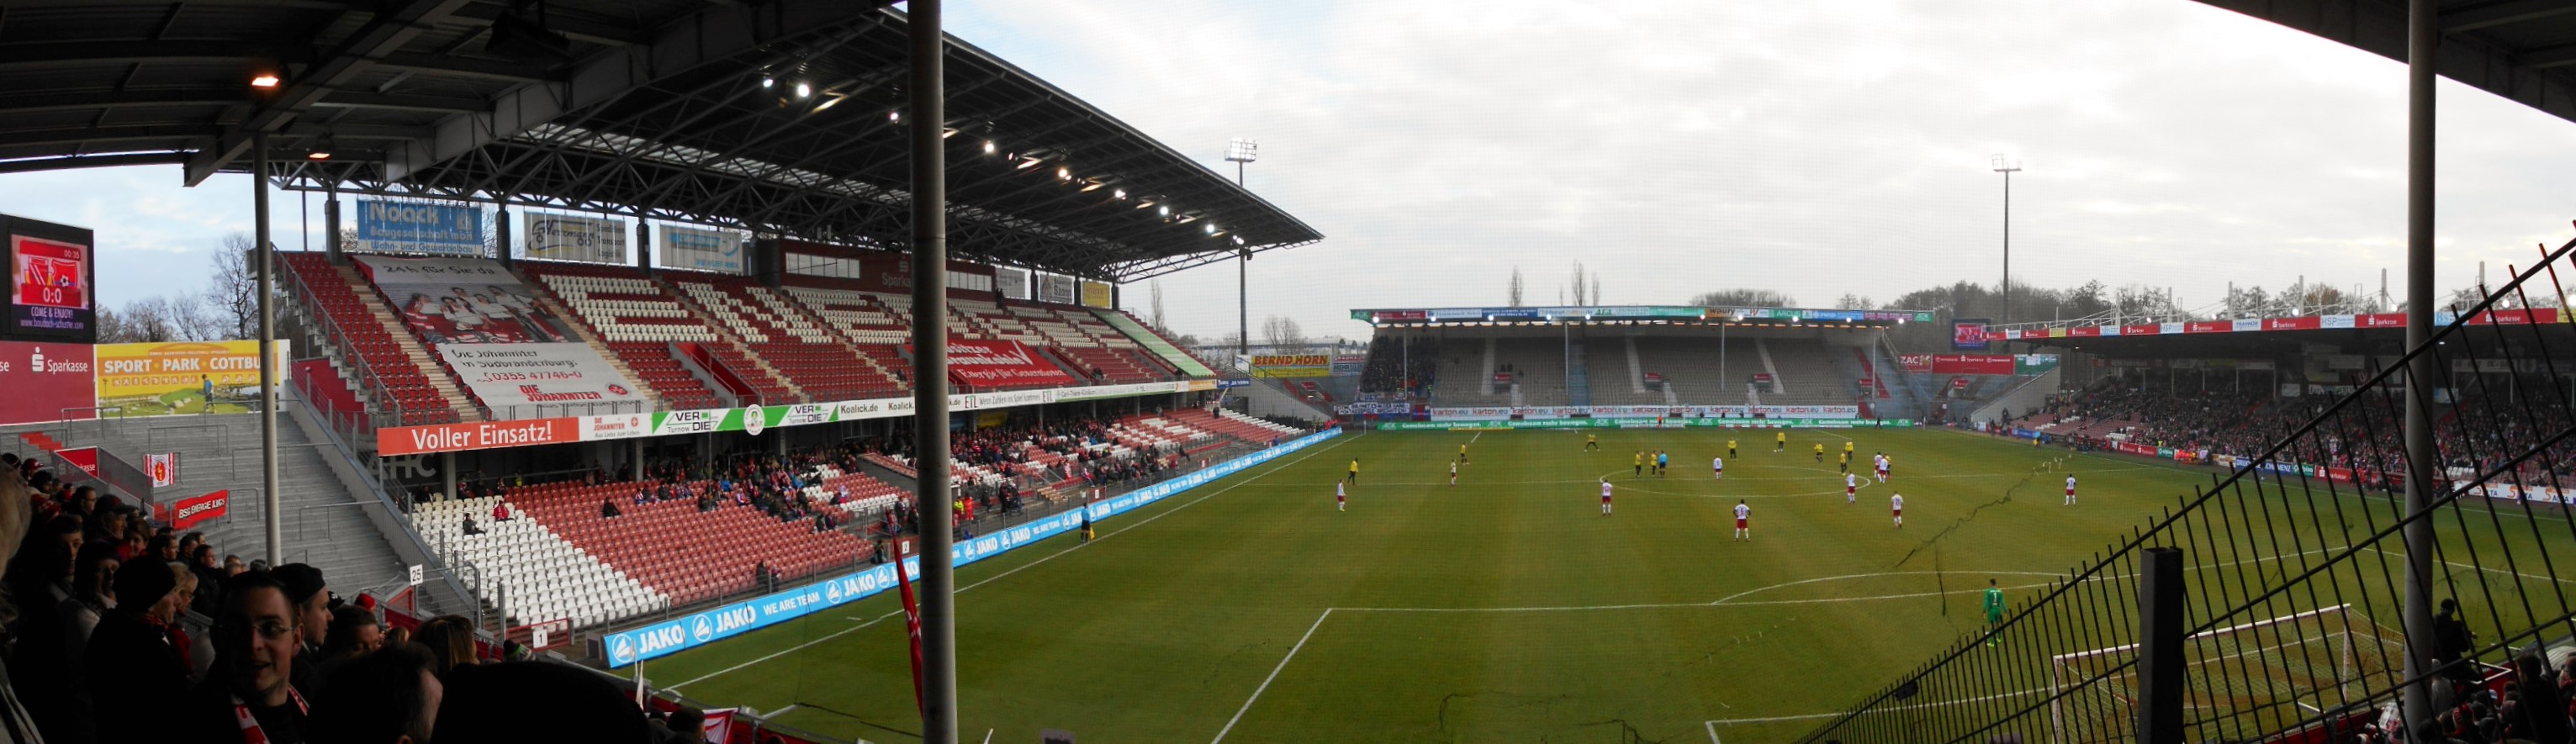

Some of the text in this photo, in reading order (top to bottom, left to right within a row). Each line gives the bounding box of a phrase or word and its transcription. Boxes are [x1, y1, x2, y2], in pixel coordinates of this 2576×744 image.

[369, 203, 439, 224] Noack
[401, 242, 416, 251] und
[419, 242, 473, 252] Gewerbebau
[64, 250, 80, 259] 00:35
[881, 272, 912, 289] Sparka
[43, 287, 62, 303] 0:0
[31, 306, 47, 317] COME
[55, 308, 73, 319] ENJOY!
[947, 343, 992, 354] sitzer
[104, 356, 261, 374] SPORT PARK COTTBU
[947, 354, 1025, 365] raunkohle
[1254, 355, 1329, 366] BERND HORN
[1900, 356, 1919, 365] ZAC
[47, 359, 88, 375] Sparkasse
[493, 372, 526, 381] 0355
[519, 384, 540, 393] DIE
[527, 392, 602, 402] JOHANNITER
[796, 405, 814, 414] VER
[841, 402, 914, 414] Koalick.de Koalick.
[674, 412, 701, 421] VER
[807, 414, 822, 422] DIE
[594, 422, 625, 431] JOHANNITER
[692, 421, 711, 431] DIE
[411, 420, 553, 450] Voller Einsatz!
[2542, 486, 2569, 503] SALA
[179, 498, 225, 519] BSG ENERGIE JUNGS
[976, 537, 997, 555] JAKO
[1011, 527, 1030, 544] JAKO
[1097, 503, 1111, 517] JAKO
[412, 569, 421, 582] 25
[640, 561, 918, 654] JAKO JAKO WE ARE TEAM JAKO JKO
[539, 634, 542, 644] 1
